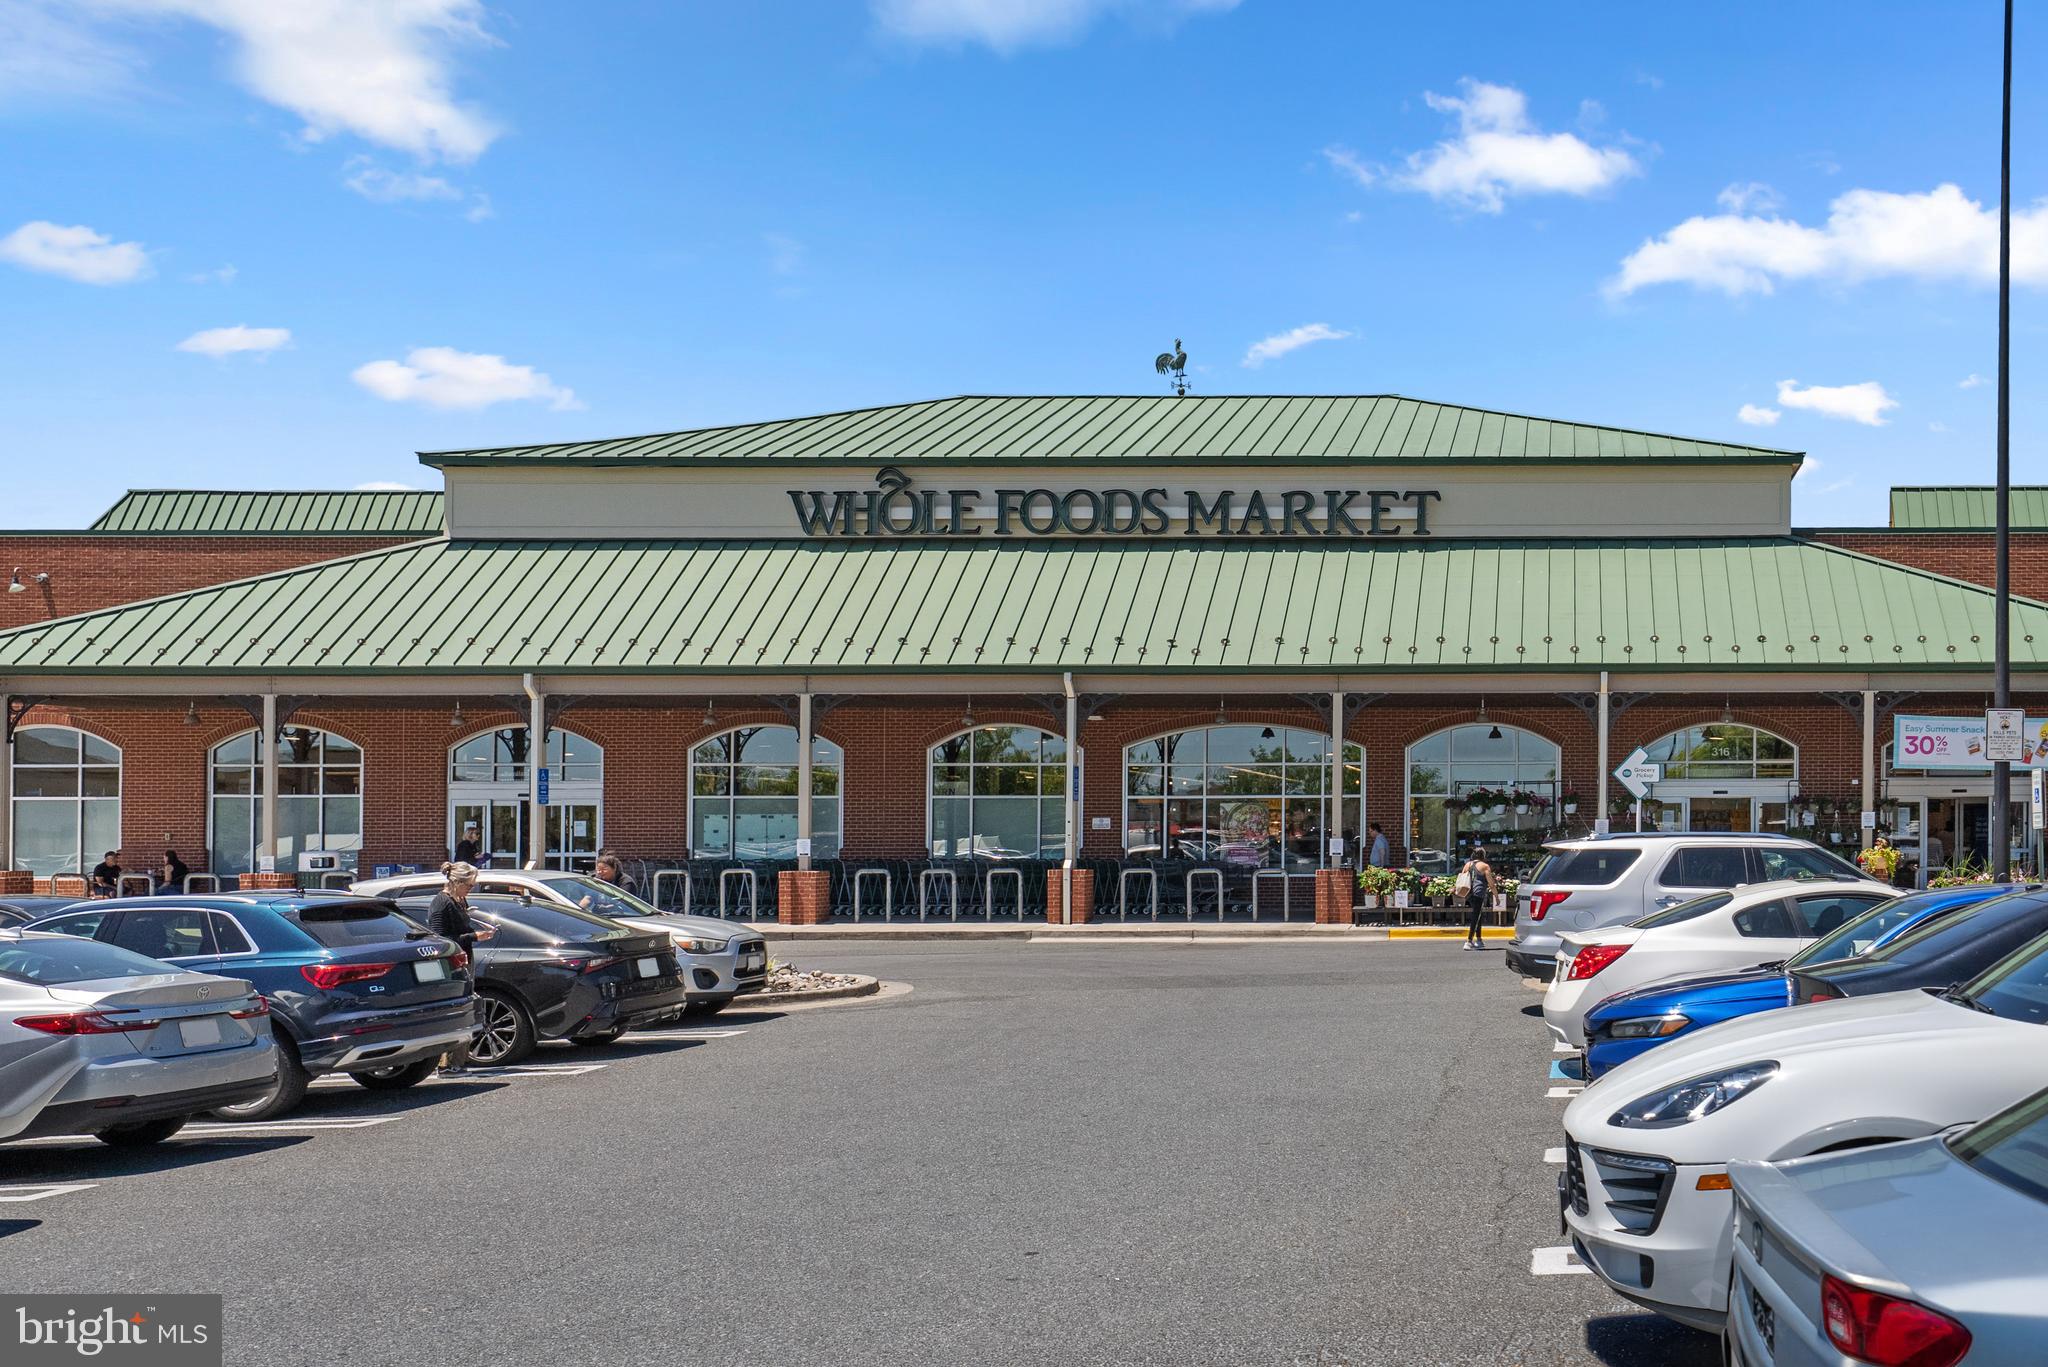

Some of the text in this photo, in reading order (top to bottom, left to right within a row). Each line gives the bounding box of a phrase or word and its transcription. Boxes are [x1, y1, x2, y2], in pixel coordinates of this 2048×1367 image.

[786, 466, 1441, 535] WHOLE FOODS MARKET
[1905, 724, 1924, 733] Easy
[1925, 725, 1959, 733] Summer
[1711, 747, 1730, 757] 316
